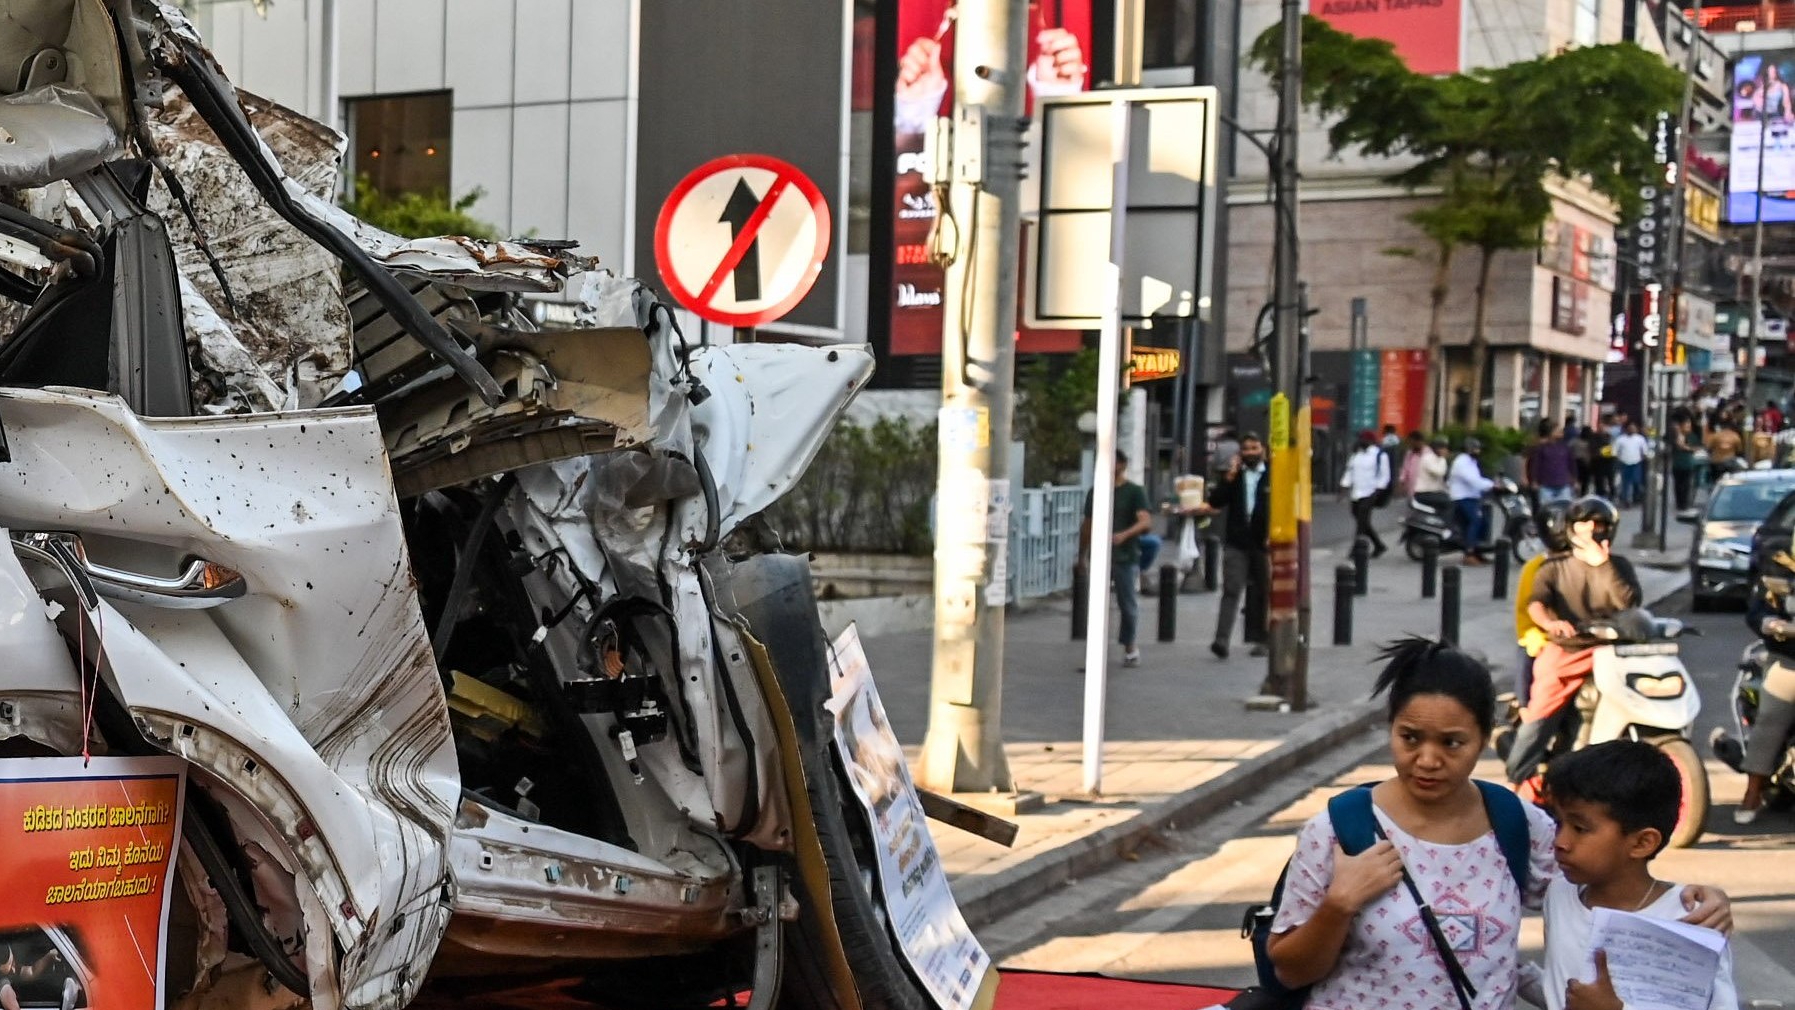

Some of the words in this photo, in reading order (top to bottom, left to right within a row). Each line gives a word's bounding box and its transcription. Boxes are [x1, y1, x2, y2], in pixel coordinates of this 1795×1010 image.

[23, 804, 63, 832] ಕುಡಿತದ
[65, 803, 107, 829] ನಂತರದ
[109, 799, 169, 828] ಚಾಲನೆಗಾಗಿ?
[69, 845, 94, 872] ಇದು
[96, 843, 122, 874] ನಿಮ್ಮ
[123, 840, 164, 866] ಕೊನೆಯ
